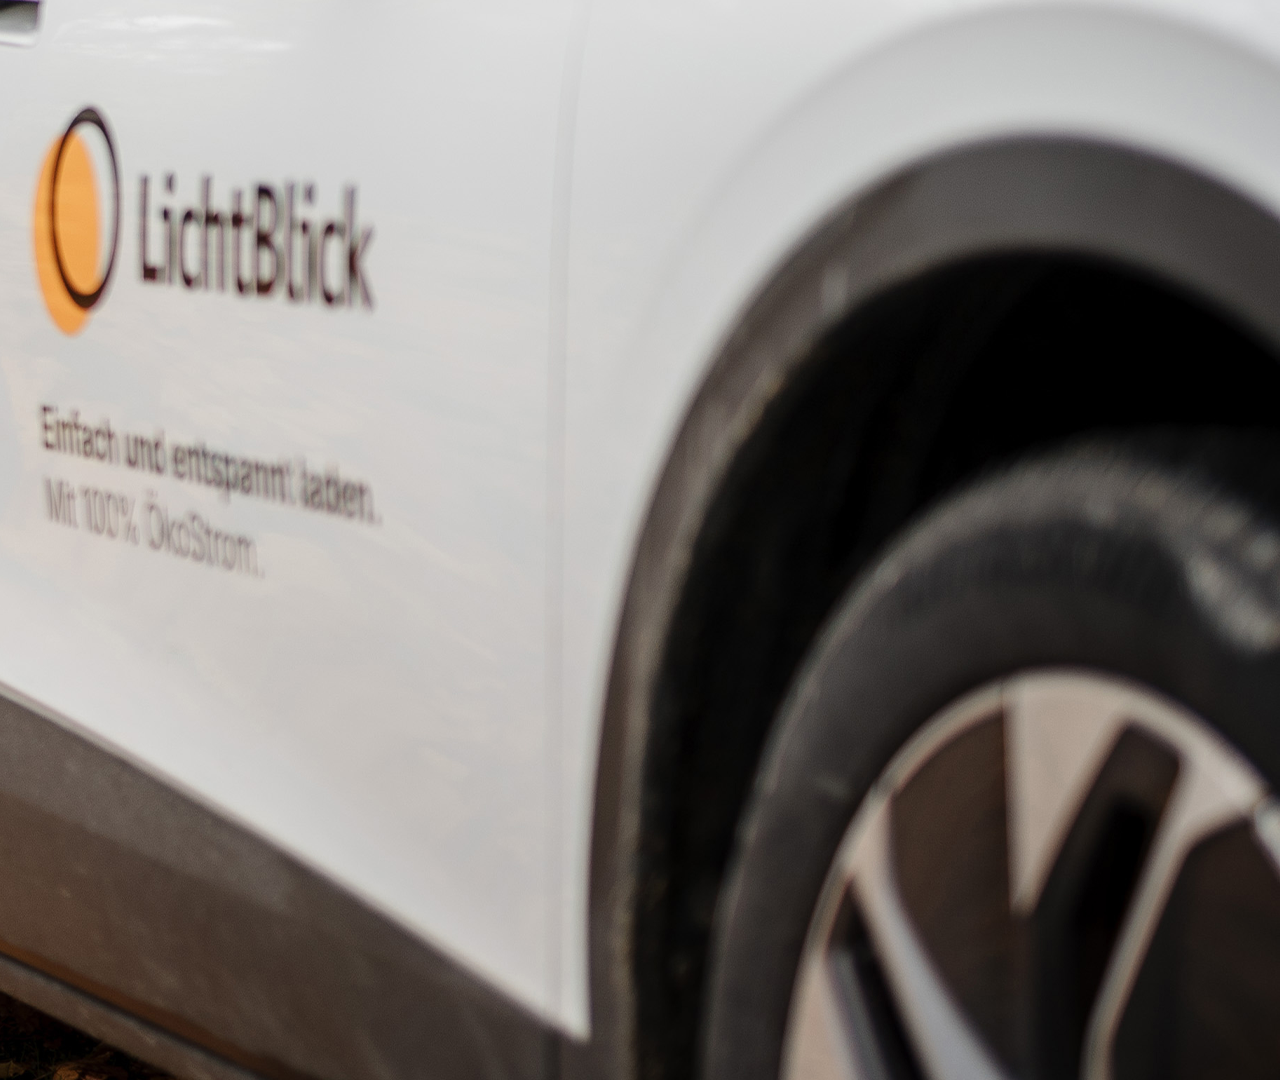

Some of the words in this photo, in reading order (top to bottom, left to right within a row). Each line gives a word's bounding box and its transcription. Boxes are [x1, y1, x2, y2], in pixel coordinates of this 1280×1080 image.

[139, 173, 375, 311] LichtBlick
[41, 404, 121, 465] Einfach
[124, 429, 167, 476] und
[172, 440, 297, 507] entspannt
[294, 453, 383, 527] laden.
[44, 476, 79, 529] Mit
[81, 484, 140, 546] 100%
[144, 489, 266, 579] ÖkoStrom.
